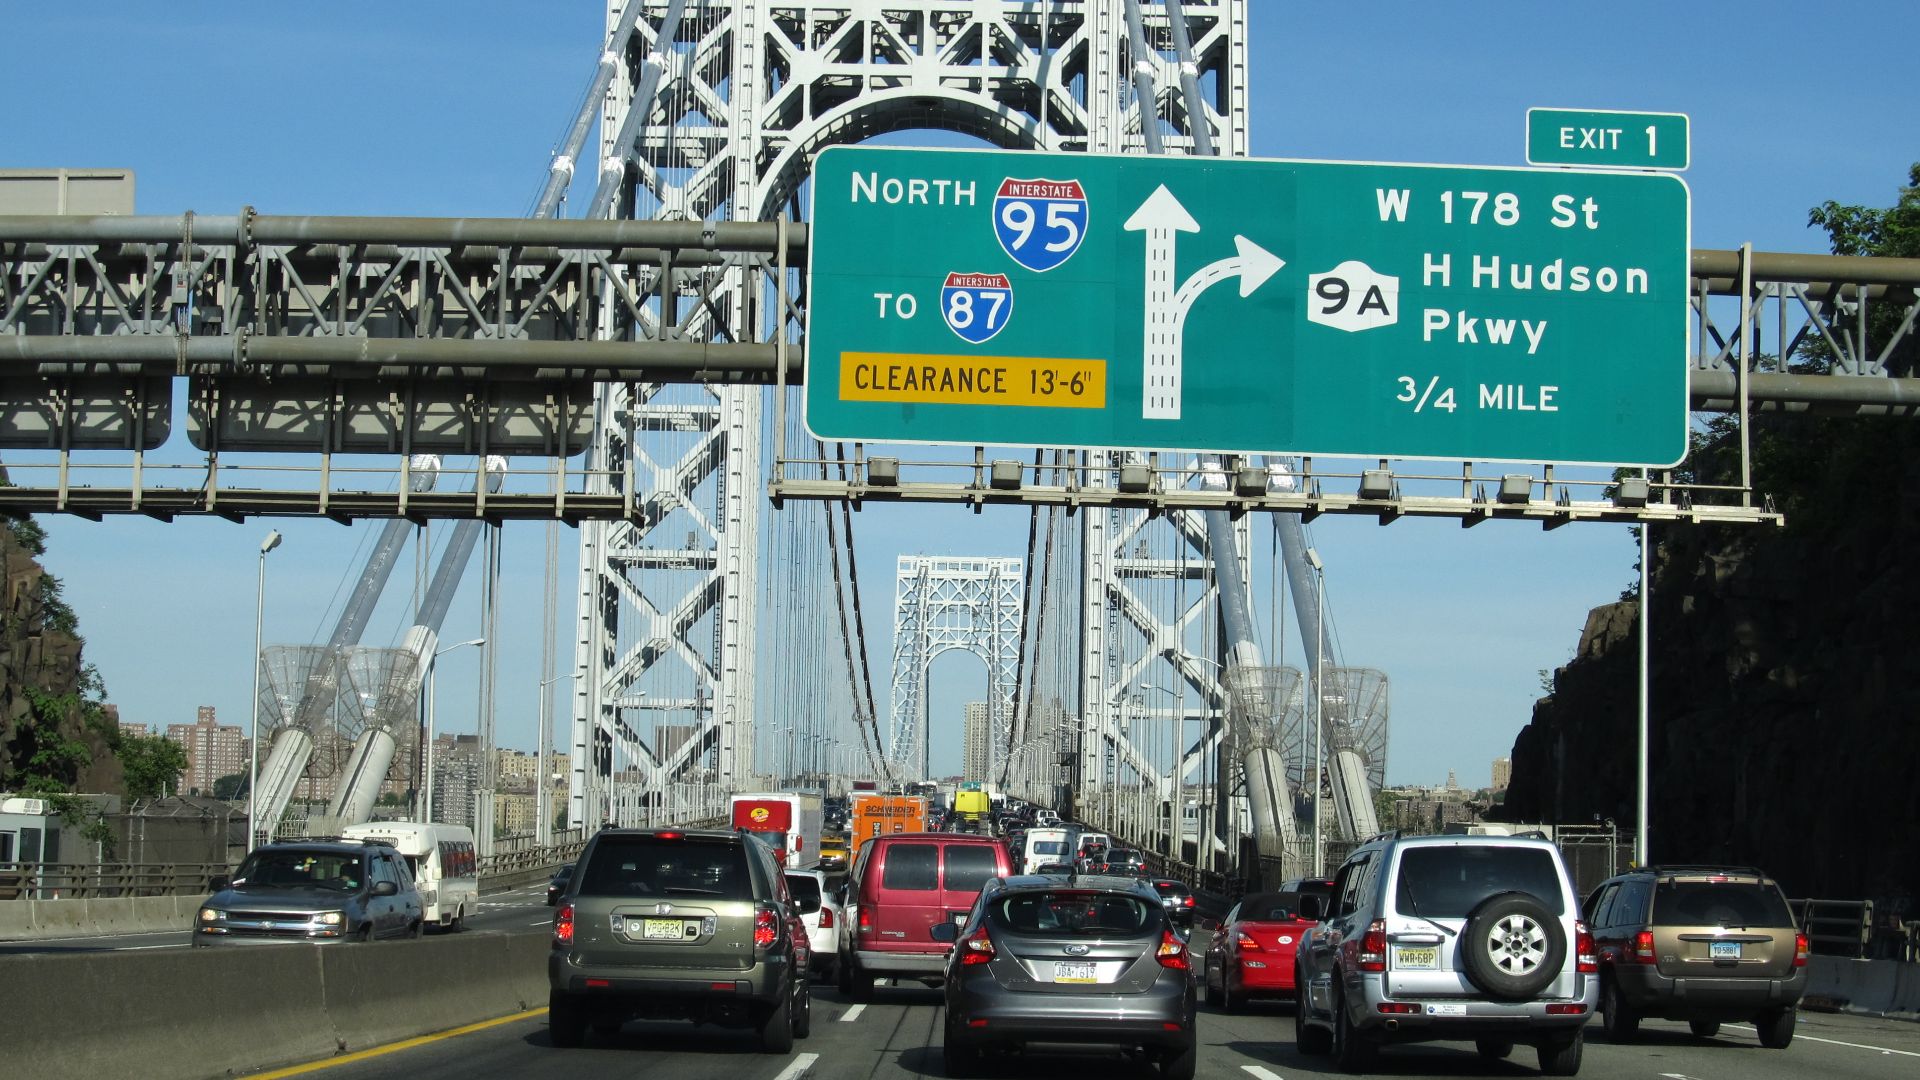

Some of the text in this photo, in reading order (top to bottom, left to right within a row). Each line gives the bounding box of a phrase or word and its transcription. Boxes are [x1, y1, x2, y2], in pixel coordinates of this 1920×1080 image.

[1560, 125, 1656, 156] EXIT 1
[851, 171, 976, 206] NORTH
[1008, 181, 1074, 198] INTERSTATE
[1376, 188, 1599, 230] W 178 St
[1001, 201, 1079, 253] 95
[952, 275, 1003, 287] INTERSTATE
[1423, 253, 1648, 294] H Hudson
[874, 293, 917, 319] TO
[947, 291, 1006, 331] 87
[1423, 308, 1547, 354] Pkwy
[855, 364, 1007, 393] CLEARANCE
[1397, 376, 1559, 413] 3/4 MILE
[865, 805, 915, 813] SCHNEIDER
